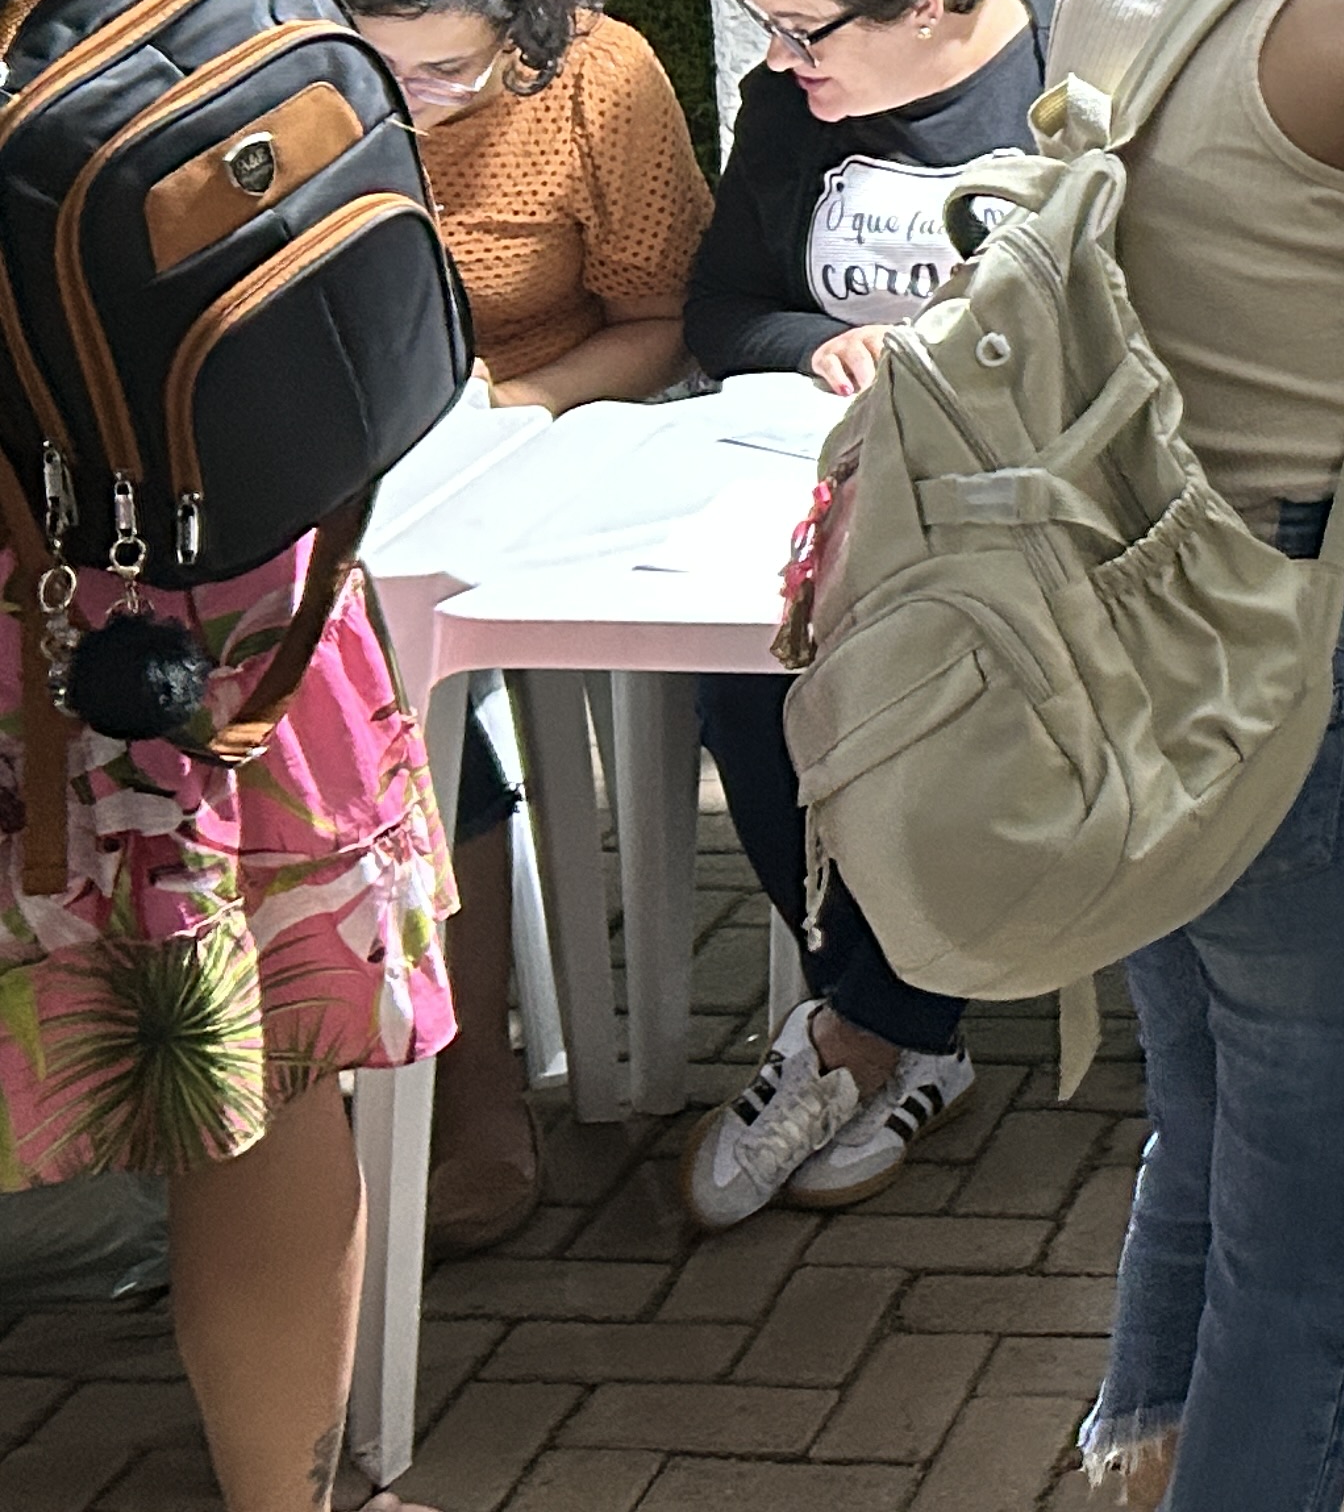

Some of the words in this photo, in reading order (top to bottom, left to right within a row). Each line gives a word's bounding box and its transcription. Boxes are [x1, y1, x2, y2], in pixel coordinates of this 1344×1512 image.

[827, 199, 844, 231] O
[851, 212, 900, 245] que
[906, 211, 946, 242] fa
[822, 262, 940, 301] cora
